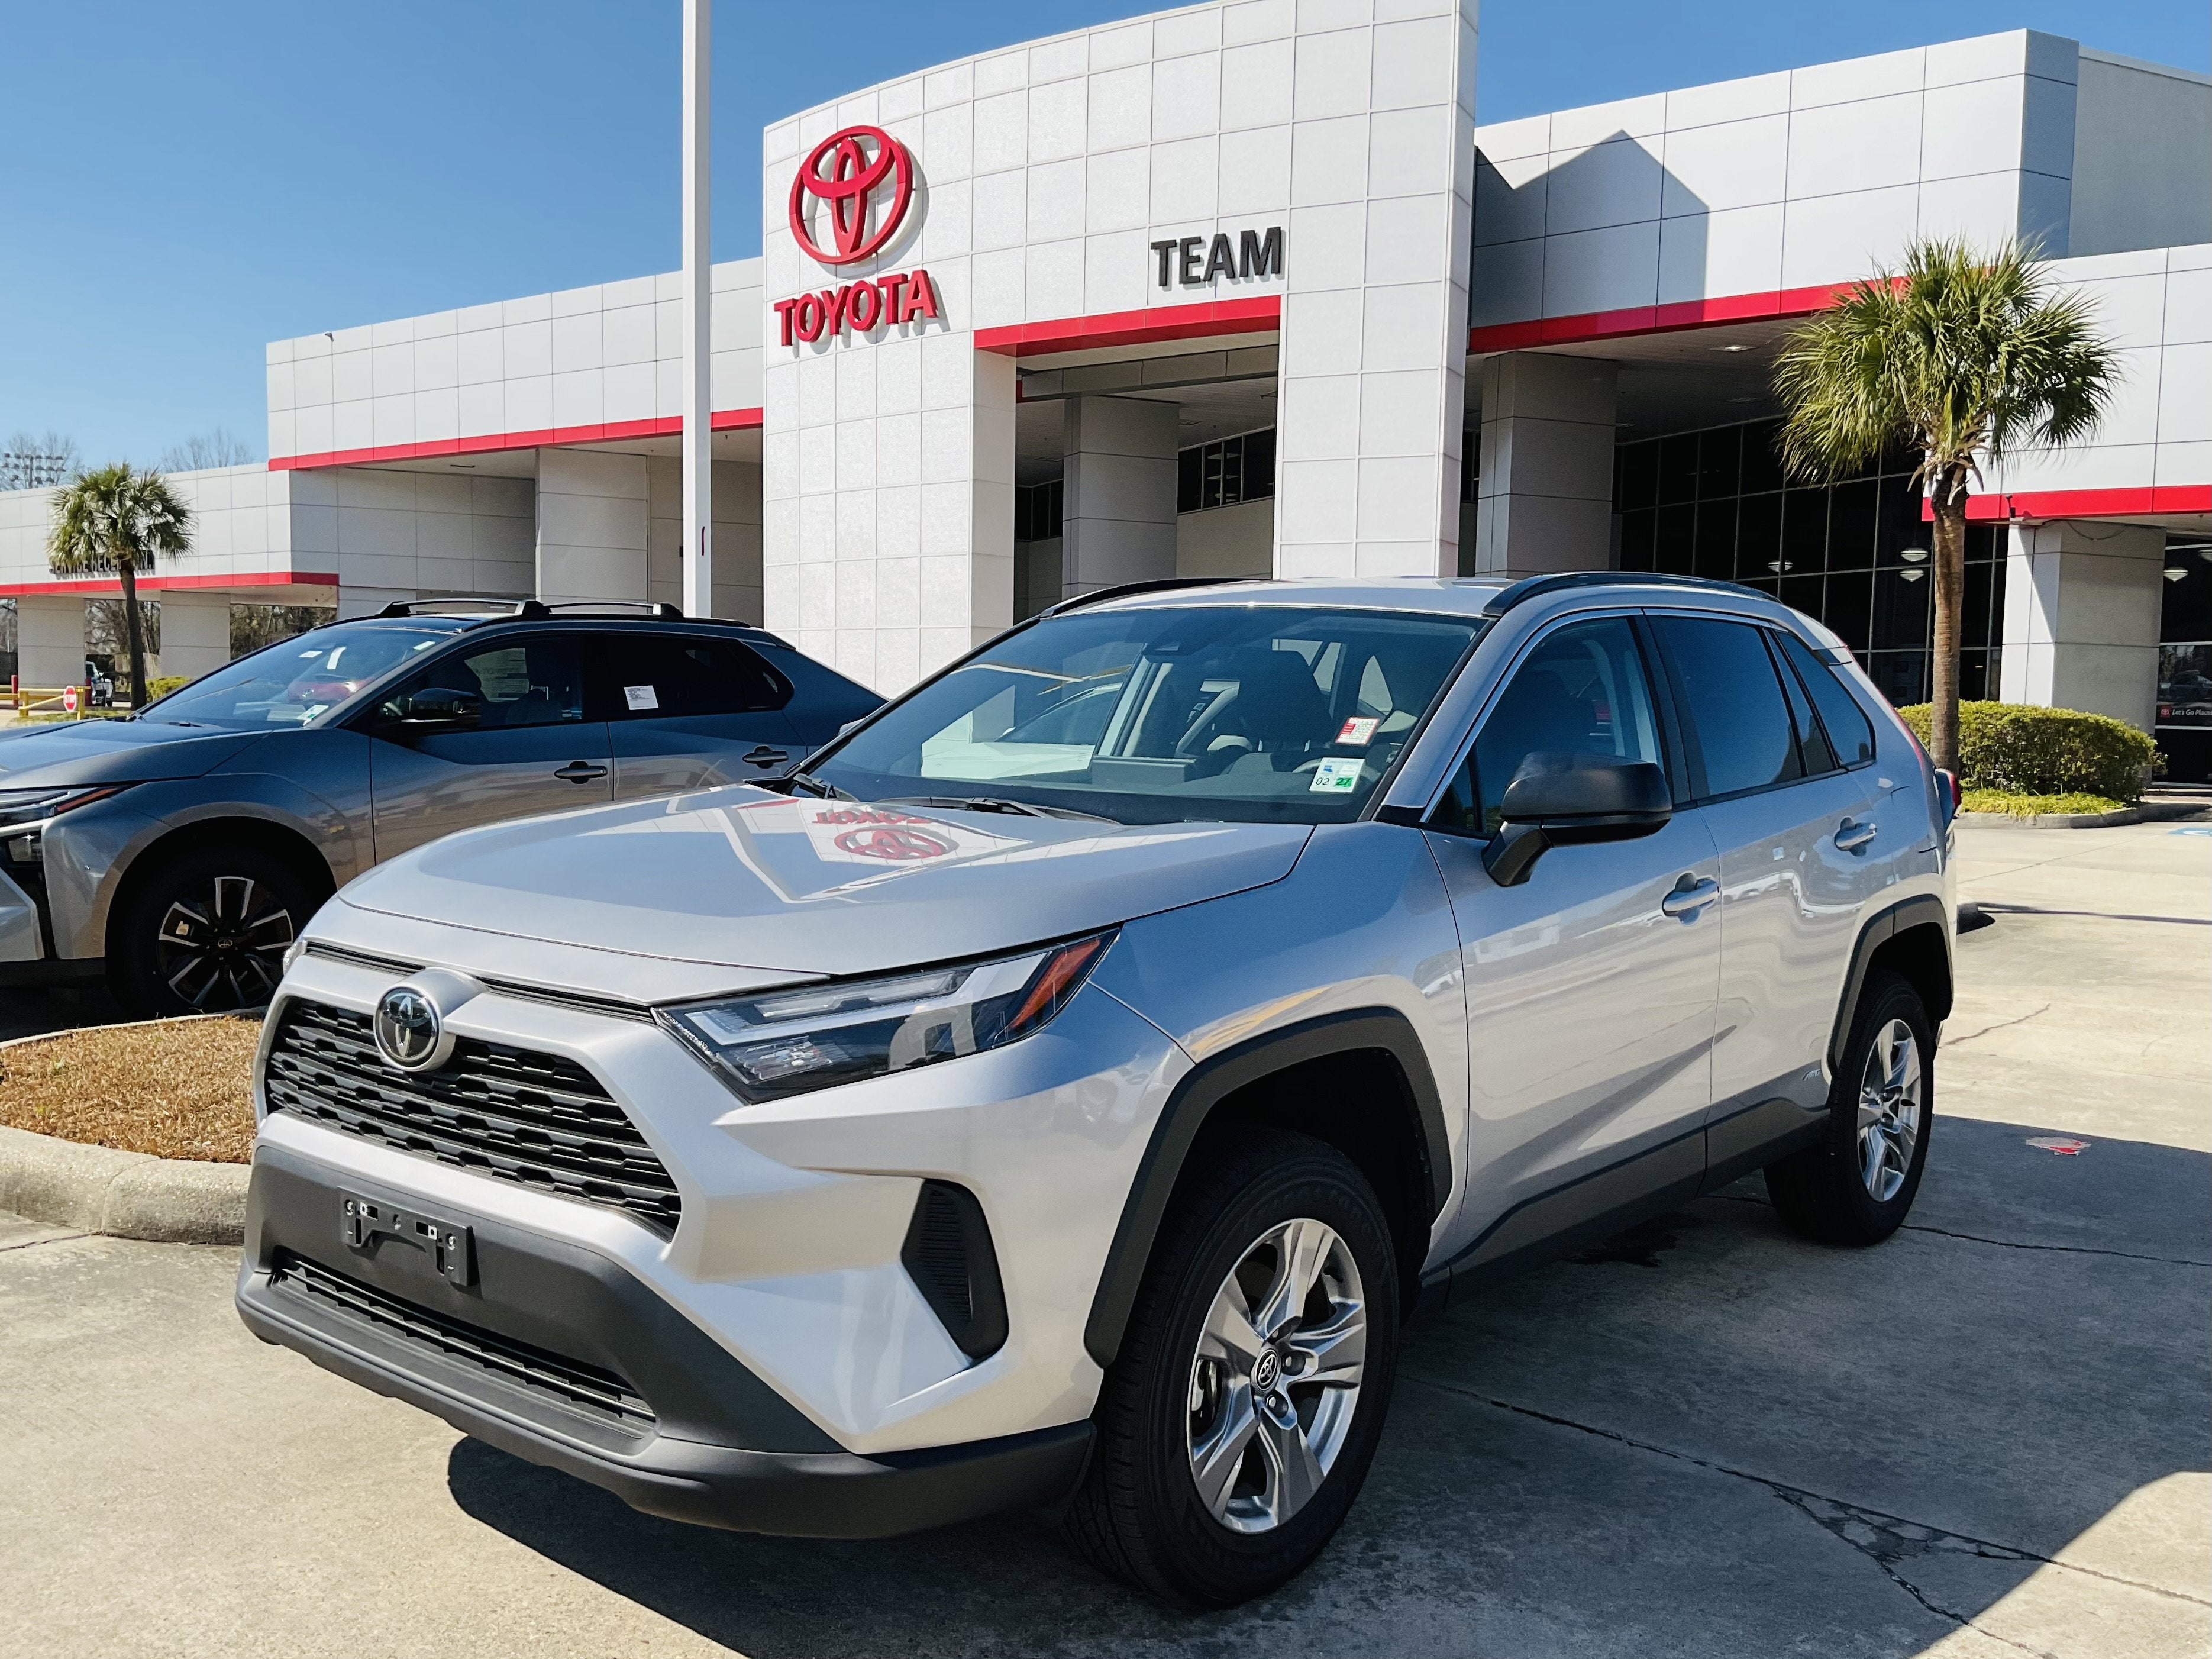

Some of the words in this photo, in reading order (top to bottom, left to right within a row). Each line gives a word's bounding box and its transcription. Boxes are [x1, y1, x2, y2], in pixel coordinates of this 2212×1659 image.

[1151, 227, 1281, 286] TEAM
[774, 269, 938, 346] TOYOTA
[1316, 777, 1330, 786] 02
[1336, 777, 1351, 786] 27
